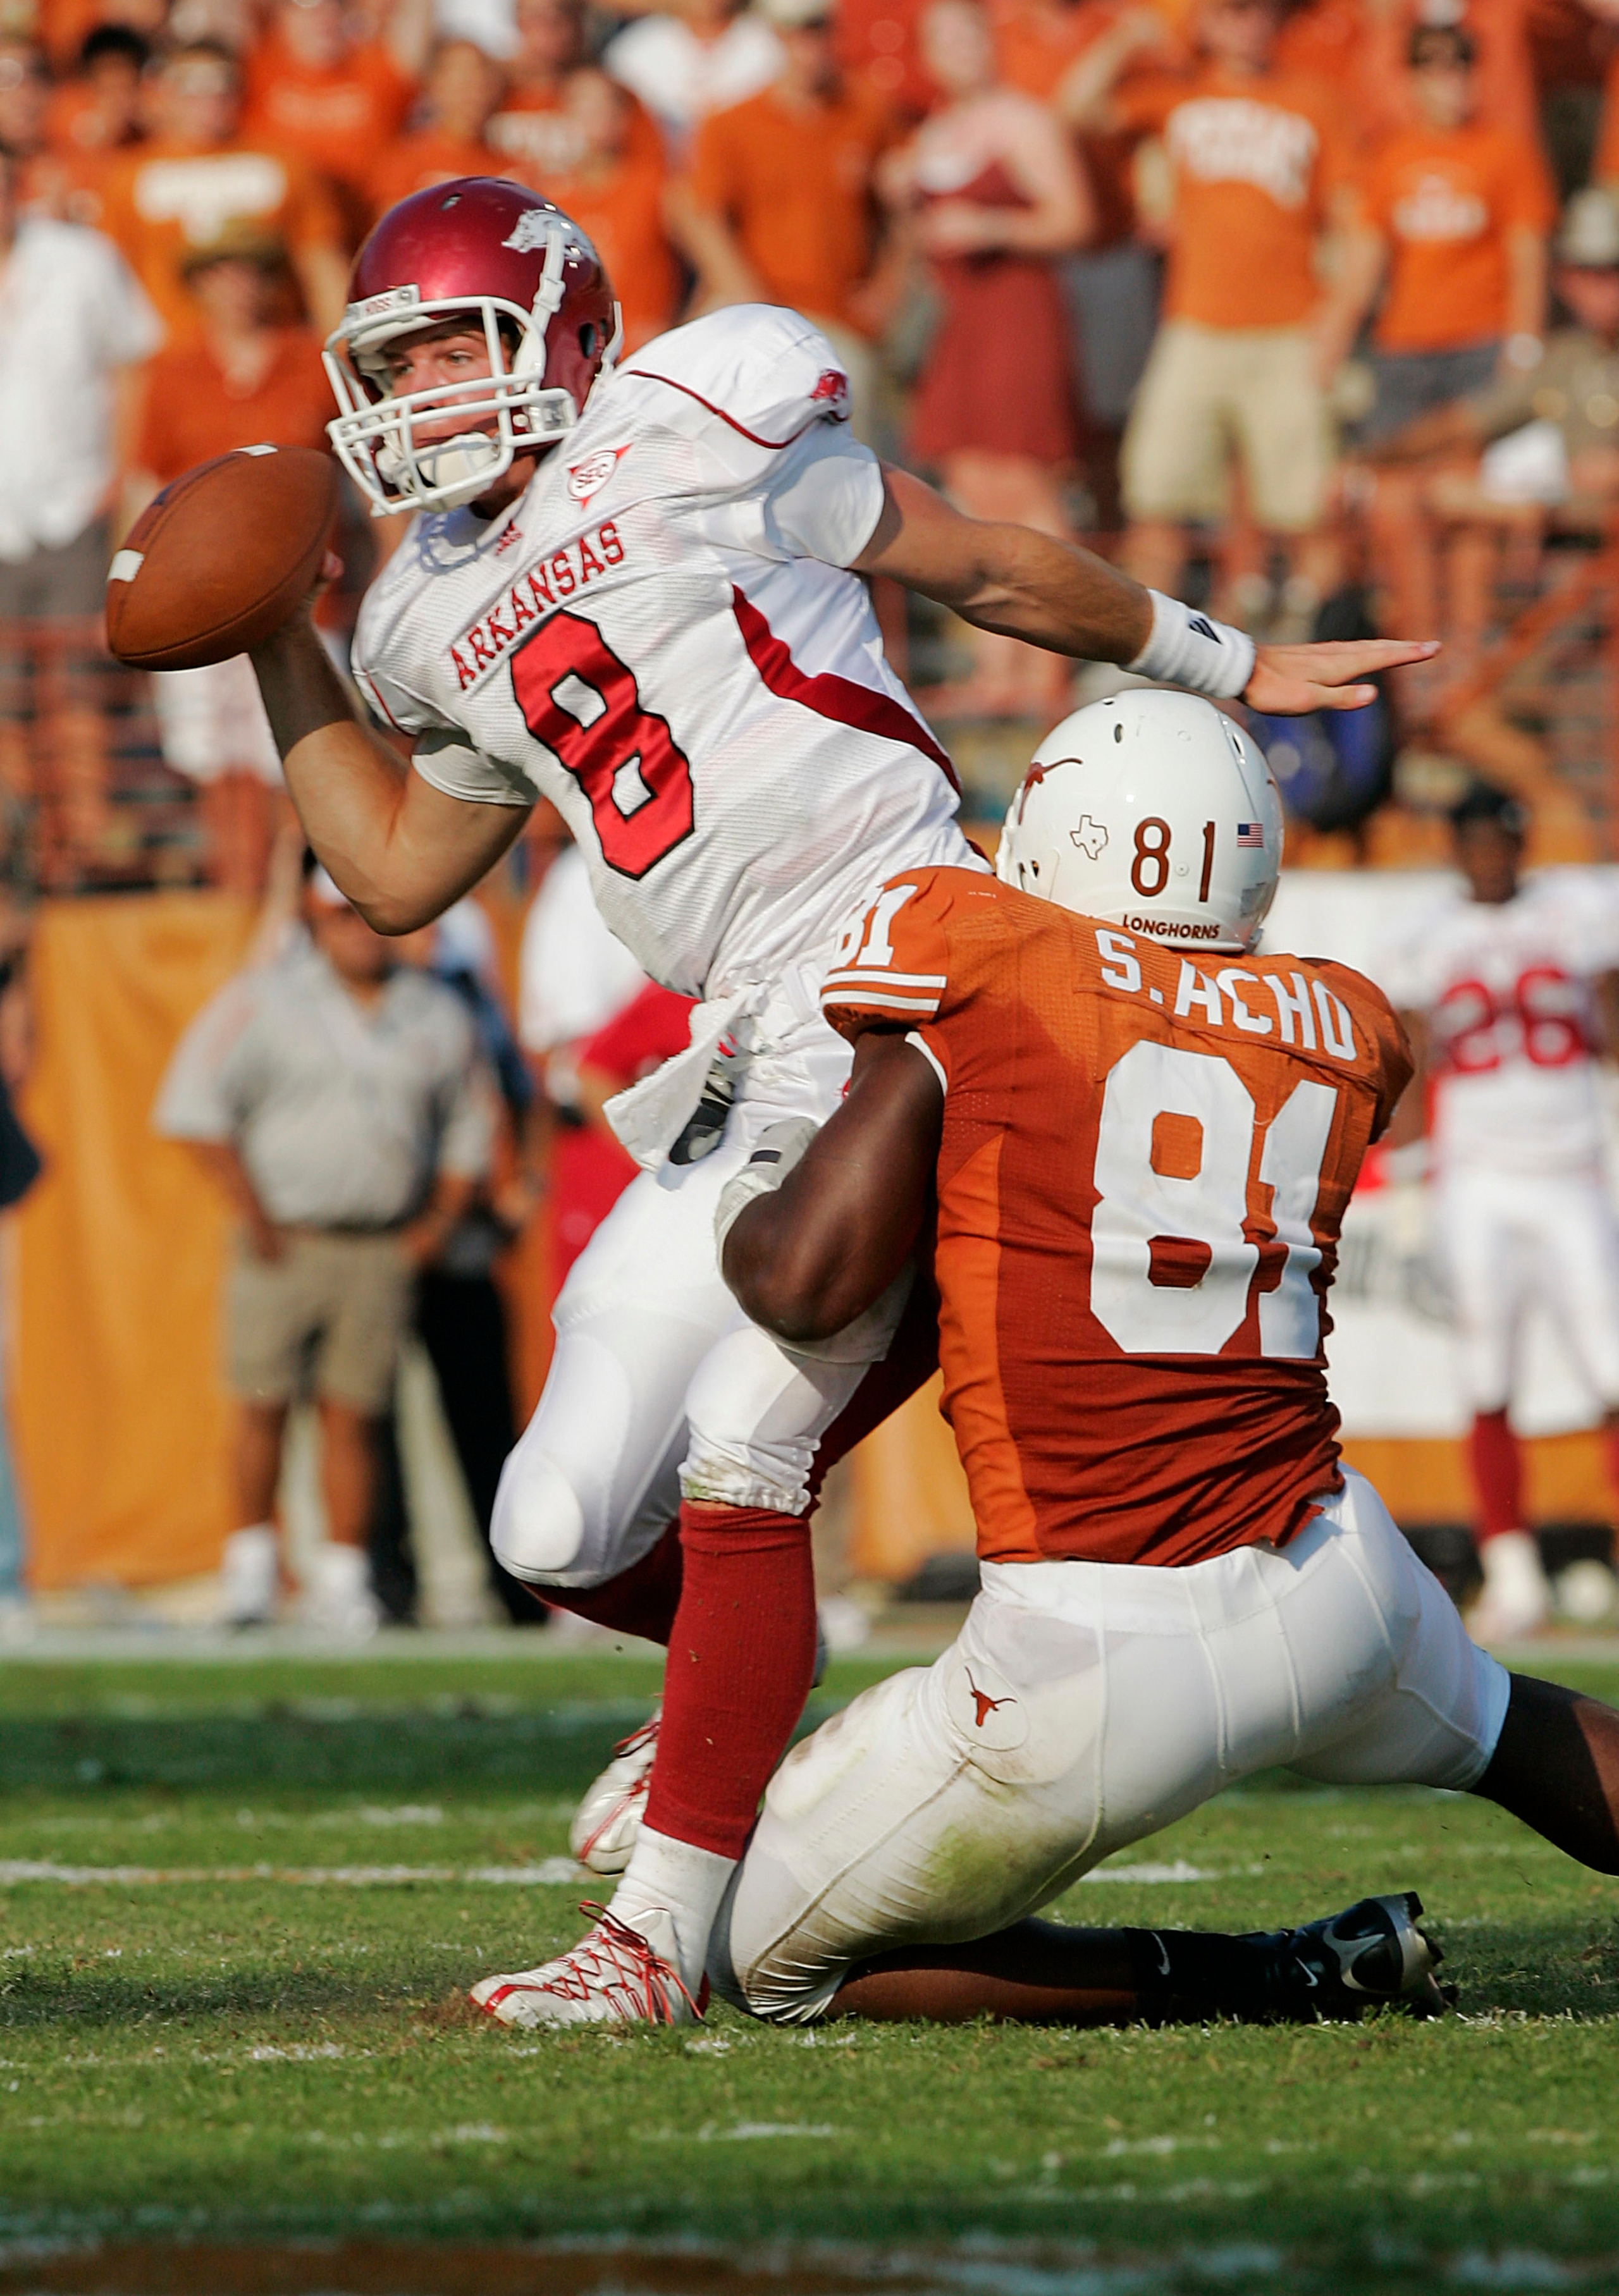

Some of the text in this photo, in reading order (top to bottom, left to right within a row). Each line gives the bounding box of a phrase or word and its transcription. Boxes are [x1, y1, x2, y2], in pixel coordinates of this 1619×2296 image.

[576, 463, 608, 489] SEC
[450, 522, 624, 690] ARKANSAS
[510, 608, 694, 881] 8
[1131, 816, 1216, 902] 81
[1123, 914, 1221, 939] LONGHORNS
[1437, 966, 1584, 1071] 26
[1090, 1039, 1338, 1360] 81
